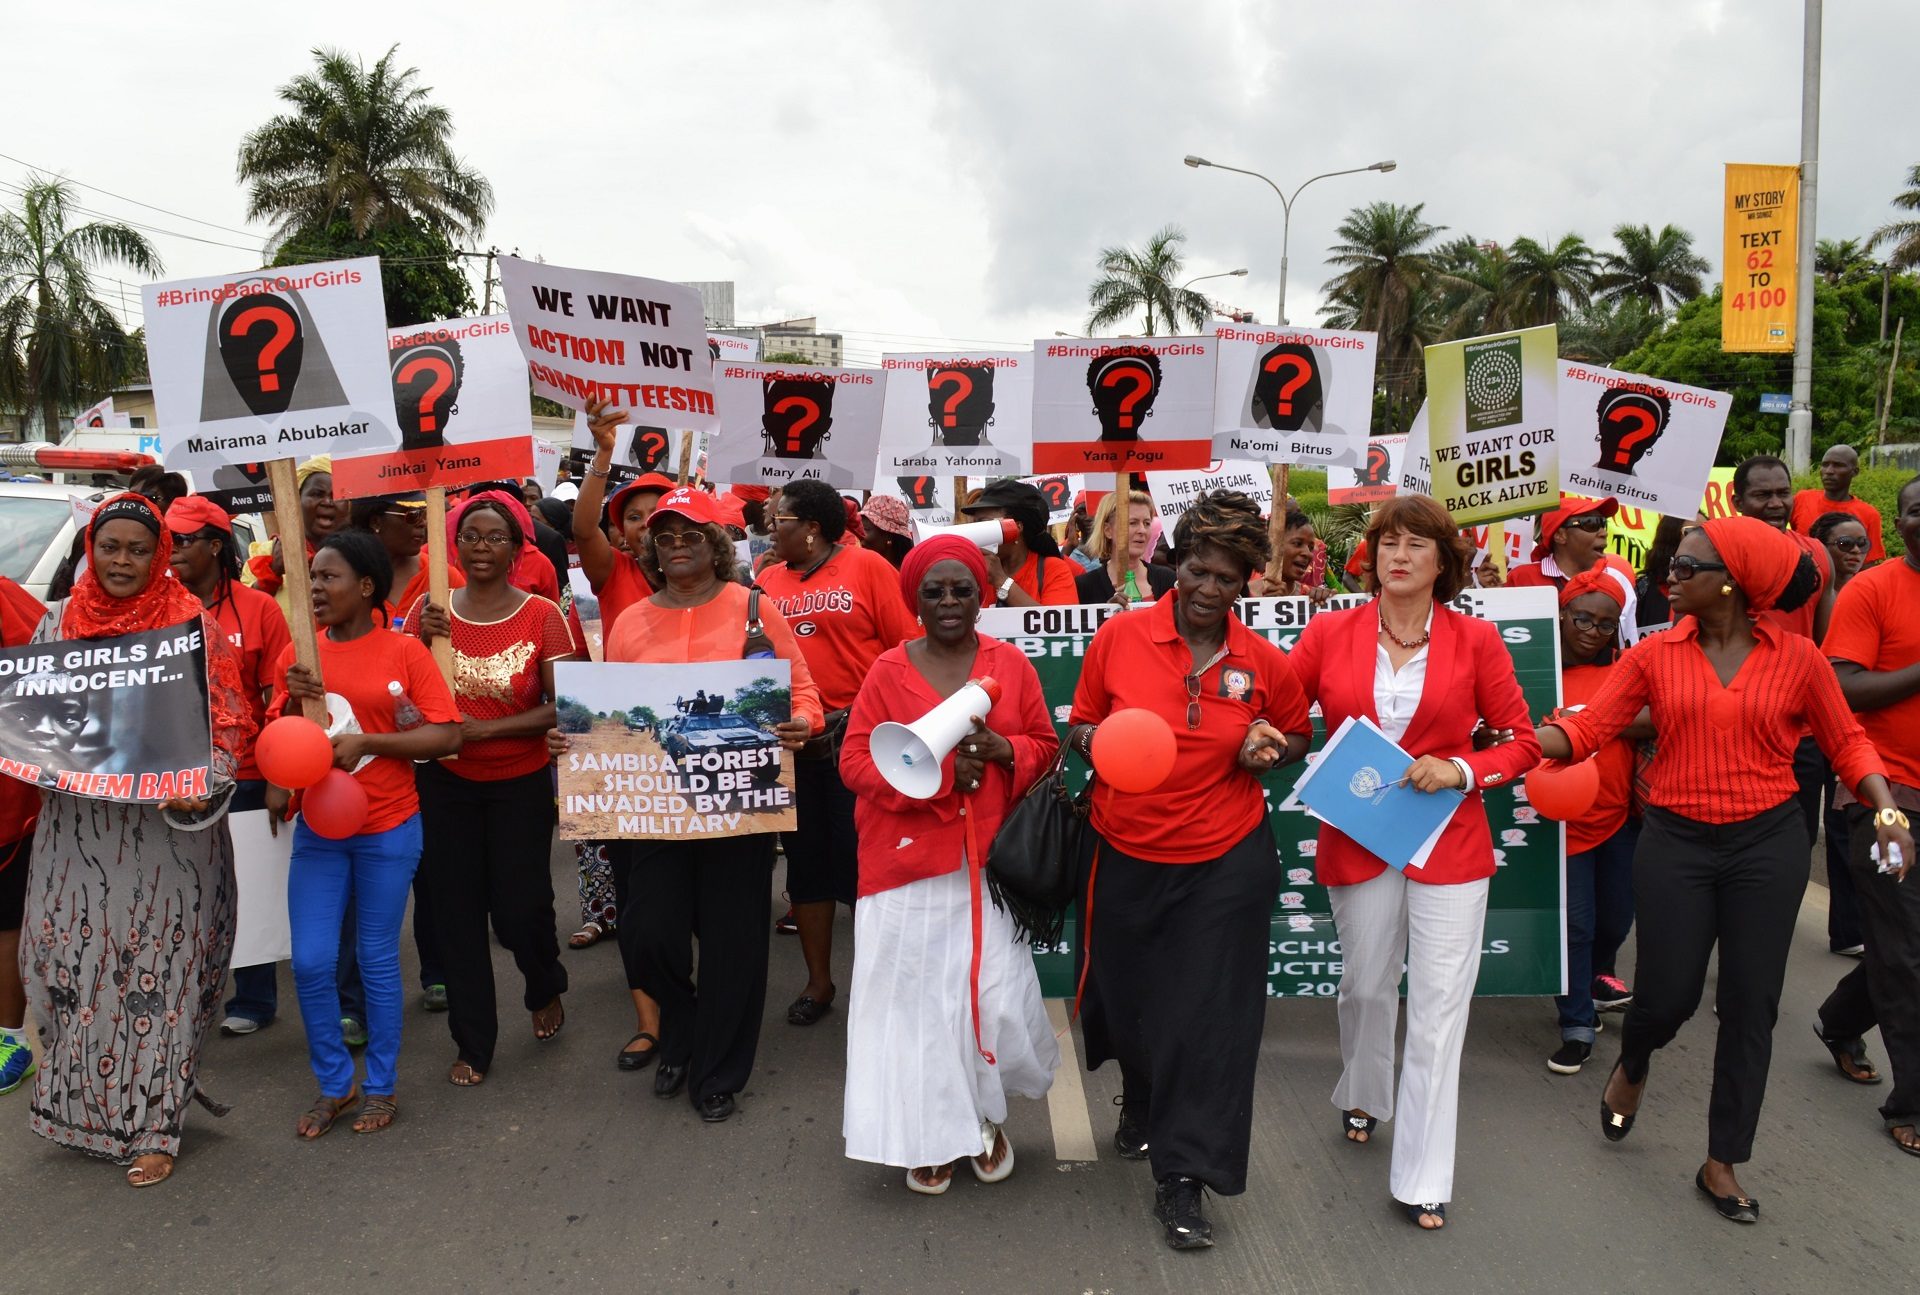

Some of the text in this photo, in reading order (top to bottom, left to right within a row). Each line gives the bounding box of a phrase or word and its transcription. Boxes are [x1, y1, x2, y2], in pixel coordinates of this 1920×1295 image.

[1735, 190, 1785, 209] MY STORY
[1740, 230, 1782, 248] TEXT
[1747, 249, 1774, 270] 62
[156, 269, 362, 307] #BringBackOurGirls
[1748, 272, 1770, 288] TO
[532, 286, 671, 327] WE WANT
[1732, 288, 1787, 311] 4100
[527, 324, 693, 371] ACTION! NOT
[1215, 327, 1365, 350] #BringBackOurGirls
[1047, 344, 1205, 359] #BringBackOurGirls
[724, 367, 873, 385] #BringBackOurGirls
[881, 357, 1018, 372] #BringBackOurGirls
[529, 360, 715, 415] COMMITTEES!!!
[1567, 367, 1717, 409] #BringBackOurGirls
[187, 421, 370, 453] Mairama Abubakar
[1230, 438, 1332, 456] Na'omi Bitrus
[1435, 428, 1556, 463] WE WANT OUR
[378, 457, 481, 478] Jinkai Yama
[893, 456, 1001, 467] Laraba Yahonna
[1083, 450, 1164, 463] Yana Pogu
[1419, 456, 1431, 474] TH
[761, 467, 821, 480] Mary Ali
[1455, 450, 1537, 489] GIRLS
[1168, 473, 1257, 496] THE BLAME GAME,
[1445, 490, 1493, 512] BACK
[1497, 480, 1550, 504] ALIVE
[1569, 473, 1612, 492] Rahila
[1616, 483, 1658, 502] Bitrus
[231, 493, 273, 506] Awa Bit
[0, 654, 56, 676] OUR
[63, 643, 148, 669] GIRLS
[154, 630, 201, 659] ARE
[15, 665, 184, 696] INNOCENT...
[568, 747, 783, 773] SAMBISA FOREST
[56, 769, 134, 799] THEM
[136, 766, 209, 800] BACK
[603, 770, 752, 794] SHOULD BE
[565, 787, 791, 814] INVADED BY THE
[617, 812, 741, 835] MILITARY
